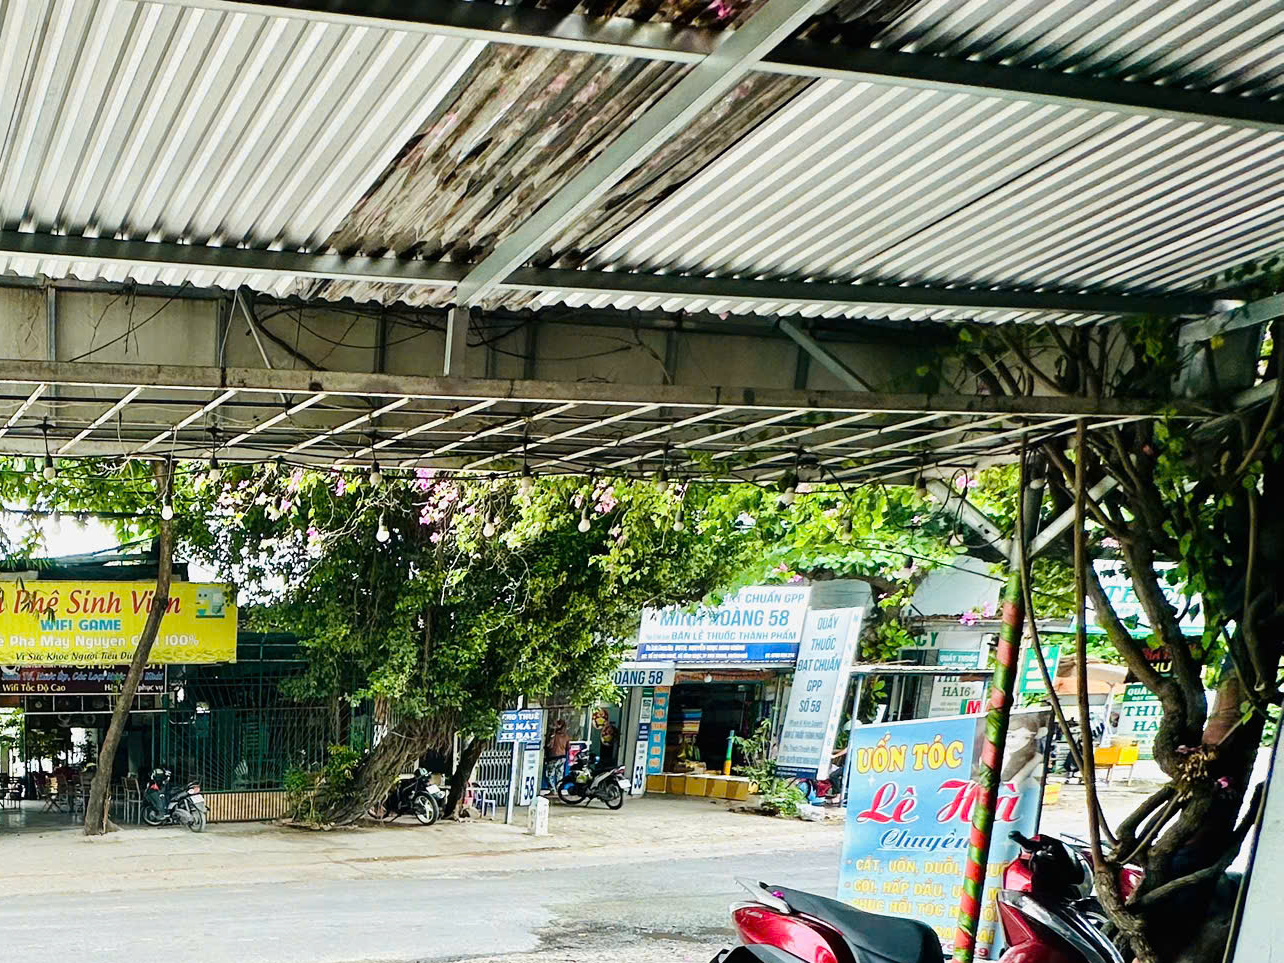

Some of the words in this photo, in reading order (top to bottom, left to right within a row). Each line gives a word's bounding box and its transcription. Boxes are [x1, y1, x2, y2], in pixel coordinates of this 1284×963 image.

[131, 589, 181, 615] Vin
[783, 593, 804, 602] GPP
[41, 619, 72, 631] WIFI
[78, 619, 121, 631] GAME
[768, 609, 790, 627] 58
[648, 670, 664, 685] 58
[806, 679, 823, 692] GPP
[2, 683, 19, 692] Wifi
[50, 684, 66, 692] Cao
[810, 700, 822, 713] 58
[856, 731, 907, 774] UỐN
[912, 733, 964, 771] TÓC
[634, 766, 643, 789] 58
[523, 776, 534, 800] 58
[855, 782, 919, 825] Lê
